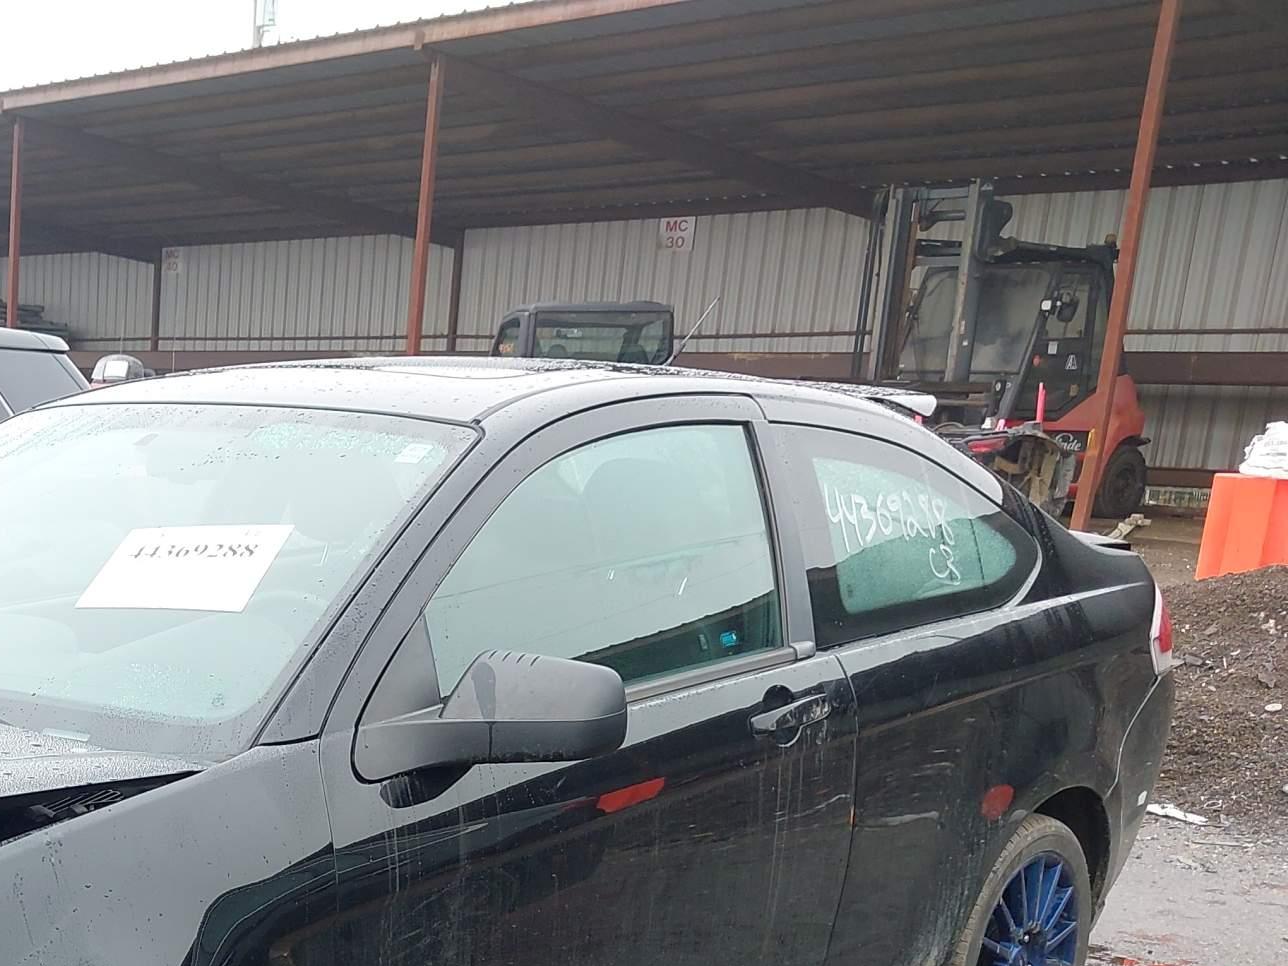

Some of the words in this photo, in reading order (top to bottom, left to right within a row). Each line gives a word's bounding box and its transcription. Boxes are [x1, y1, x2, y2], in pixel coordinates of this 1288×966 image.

[665, 220, 689, 232] MC
[665, 236, 685, 249] 30
[824, 481, 955, 553] 44369288
